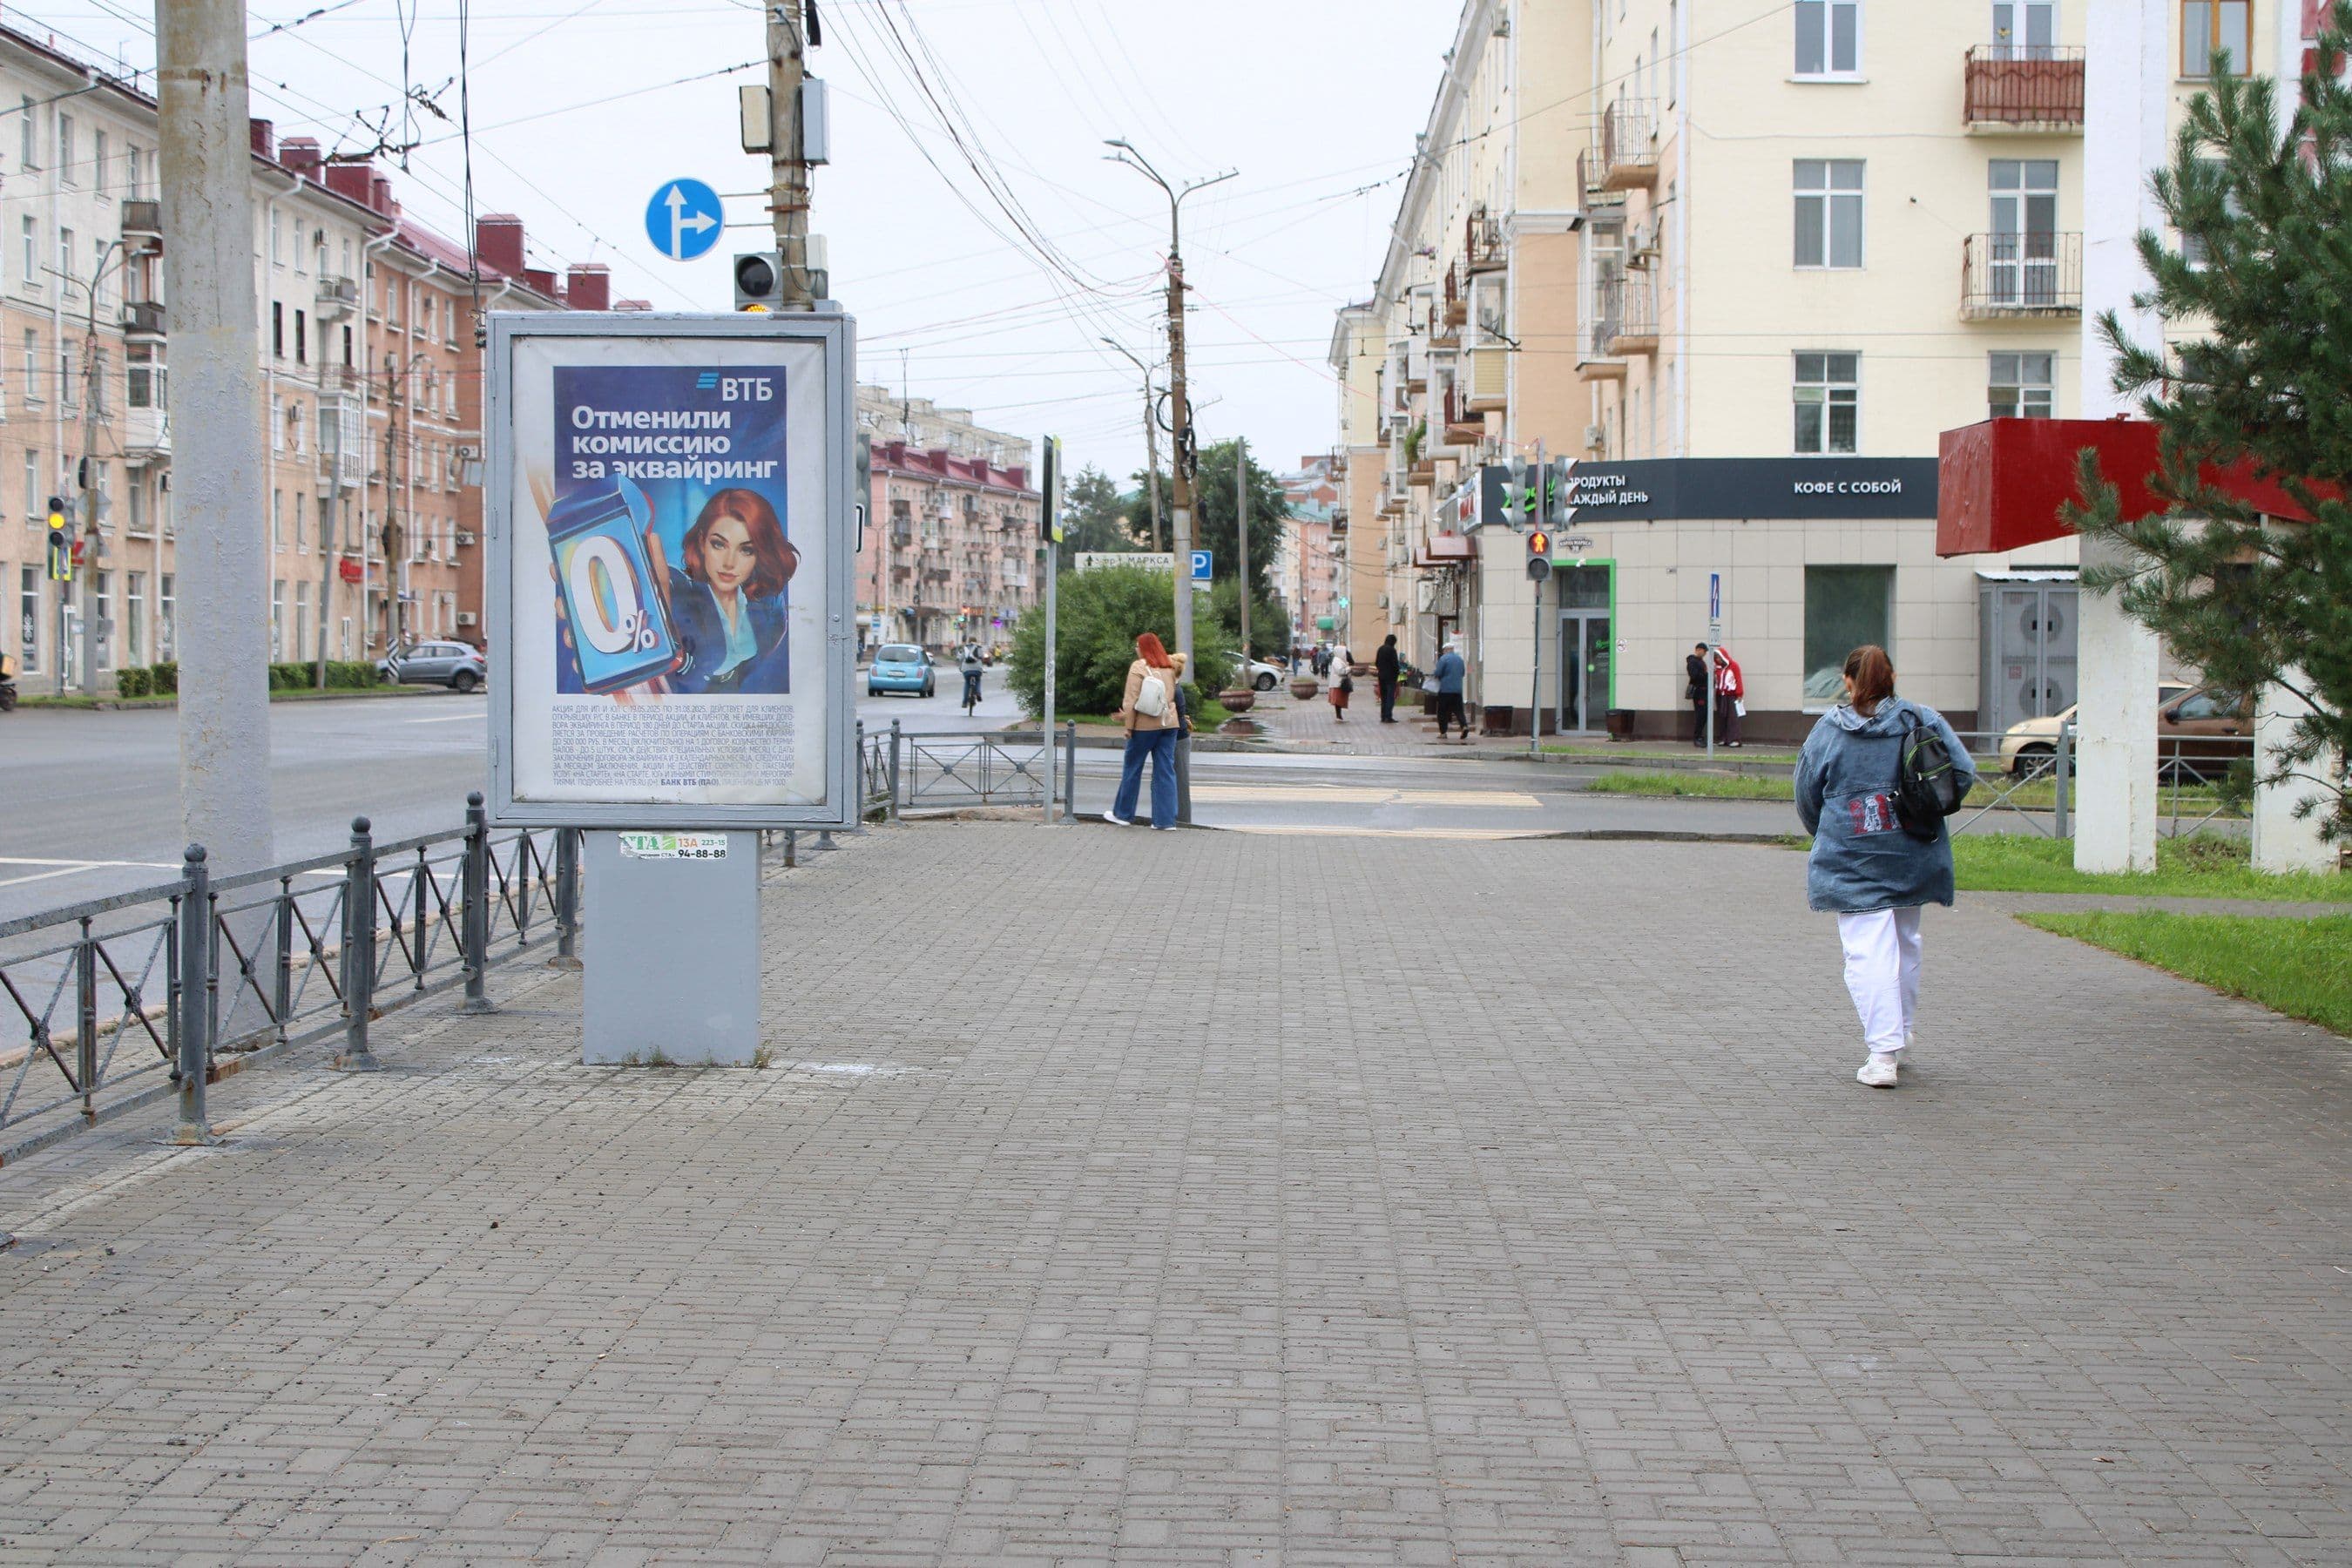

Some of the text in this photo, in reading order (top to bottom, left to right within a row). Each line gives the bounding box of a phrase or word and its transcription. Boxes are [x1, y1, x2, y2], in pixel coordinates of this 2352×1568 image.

[722, 377, 773, 402] ВТБ
[571, 405, 731, 429] Отменили
[572, 436, 731, 454] комиссию
[572, 455, 778, 485] за эквайринг
[1794, 478, 1902, 493] КОФЕ С СОБОЙ
[1570, 490, 1648, 505] АЖДЫЙ ДЕНЬ
[1128, 557, 1169, 565] МАРКСА
[1191, 553, 1207, 576] P
[570, 536, 657, 654] 0%
[612, 713, 631, 722] БАНКЕ
[639, 713, 663, 722] ПЕРИОД
[733, 713, 740, 722] НЕ
[617, 721, 640, 730] ПЕРИОД
[661, 778, 681, 787] БАНК
[684, 778, 697, 787] ВТБ
[678, 848, 726, 858] 94-88-88
